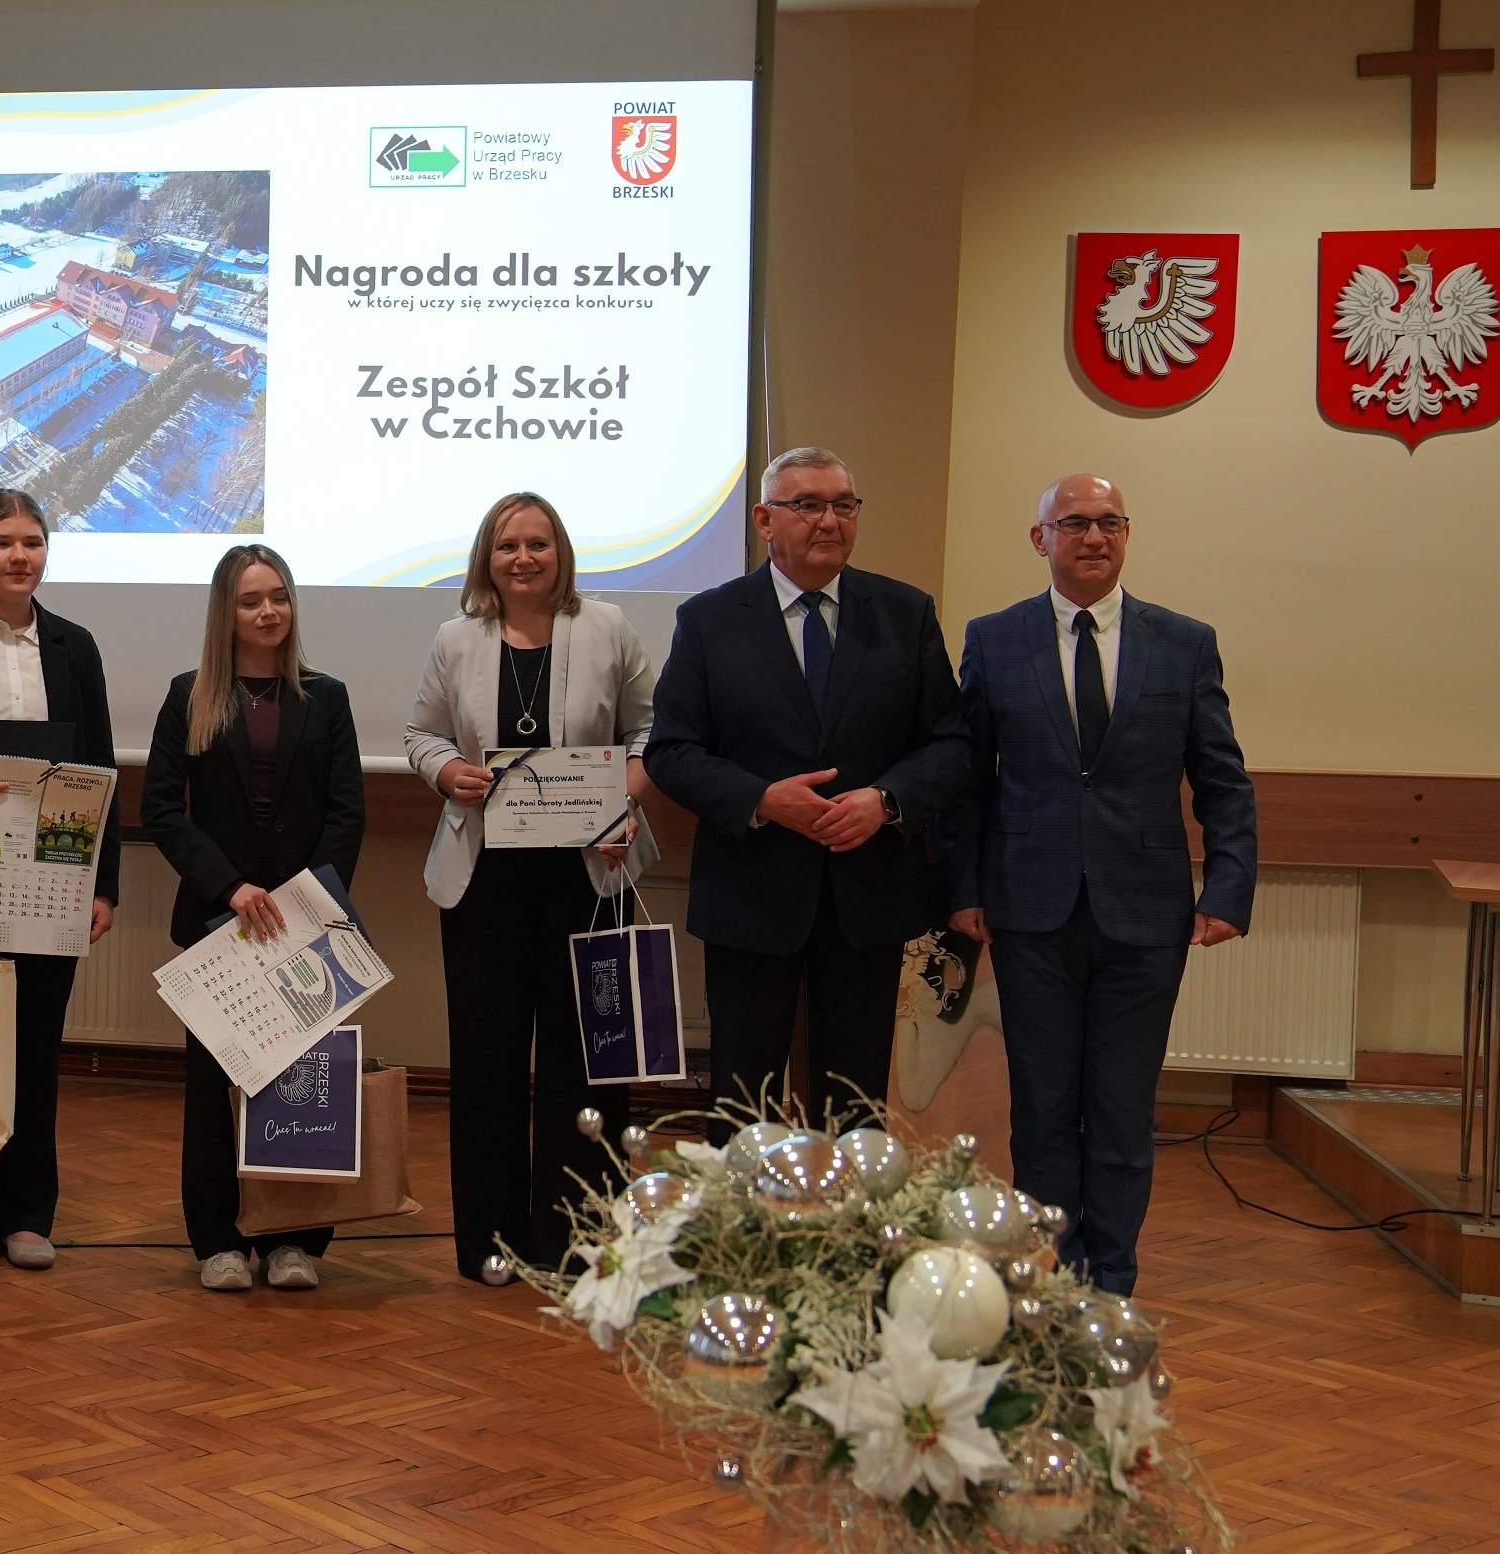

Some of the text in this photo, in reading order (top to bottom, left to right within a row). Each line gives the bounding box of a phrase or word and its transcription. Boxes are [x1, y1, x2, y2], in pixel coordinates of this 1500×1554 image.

[613, 101, 676, 115] POWIAT
[473, 131, 551, 146] Powiatowy
[473, 149, 563, 165] Urząd Pracy
[472, 167, 547, 181] w Brzesku
[612, 186, 675, 199] BRZESKI
[293, 252, 712, 297] Nagroda dla szkoły
[347, 294, 654, 312] w której uczy się zwycięzca konkursu
[356, 364, 630, 409] Zespół Szkół
[370, 405, 624, 441] w Czchowie
[63, 782, 92, 791] BRZESKO
[523, 775, 585, 784] PODZIĘKOWANIE
[519, 799, 536, 807] Pani
[537, 799, 563, 807] Doroty
[564, 798, 603, 807] Jedlińskiej
[591, 959, 612, 970] POWIAT
[611, 958, 621, 1015] BRZESKI
[318, 1052, 330, 1108] BRZESKI
